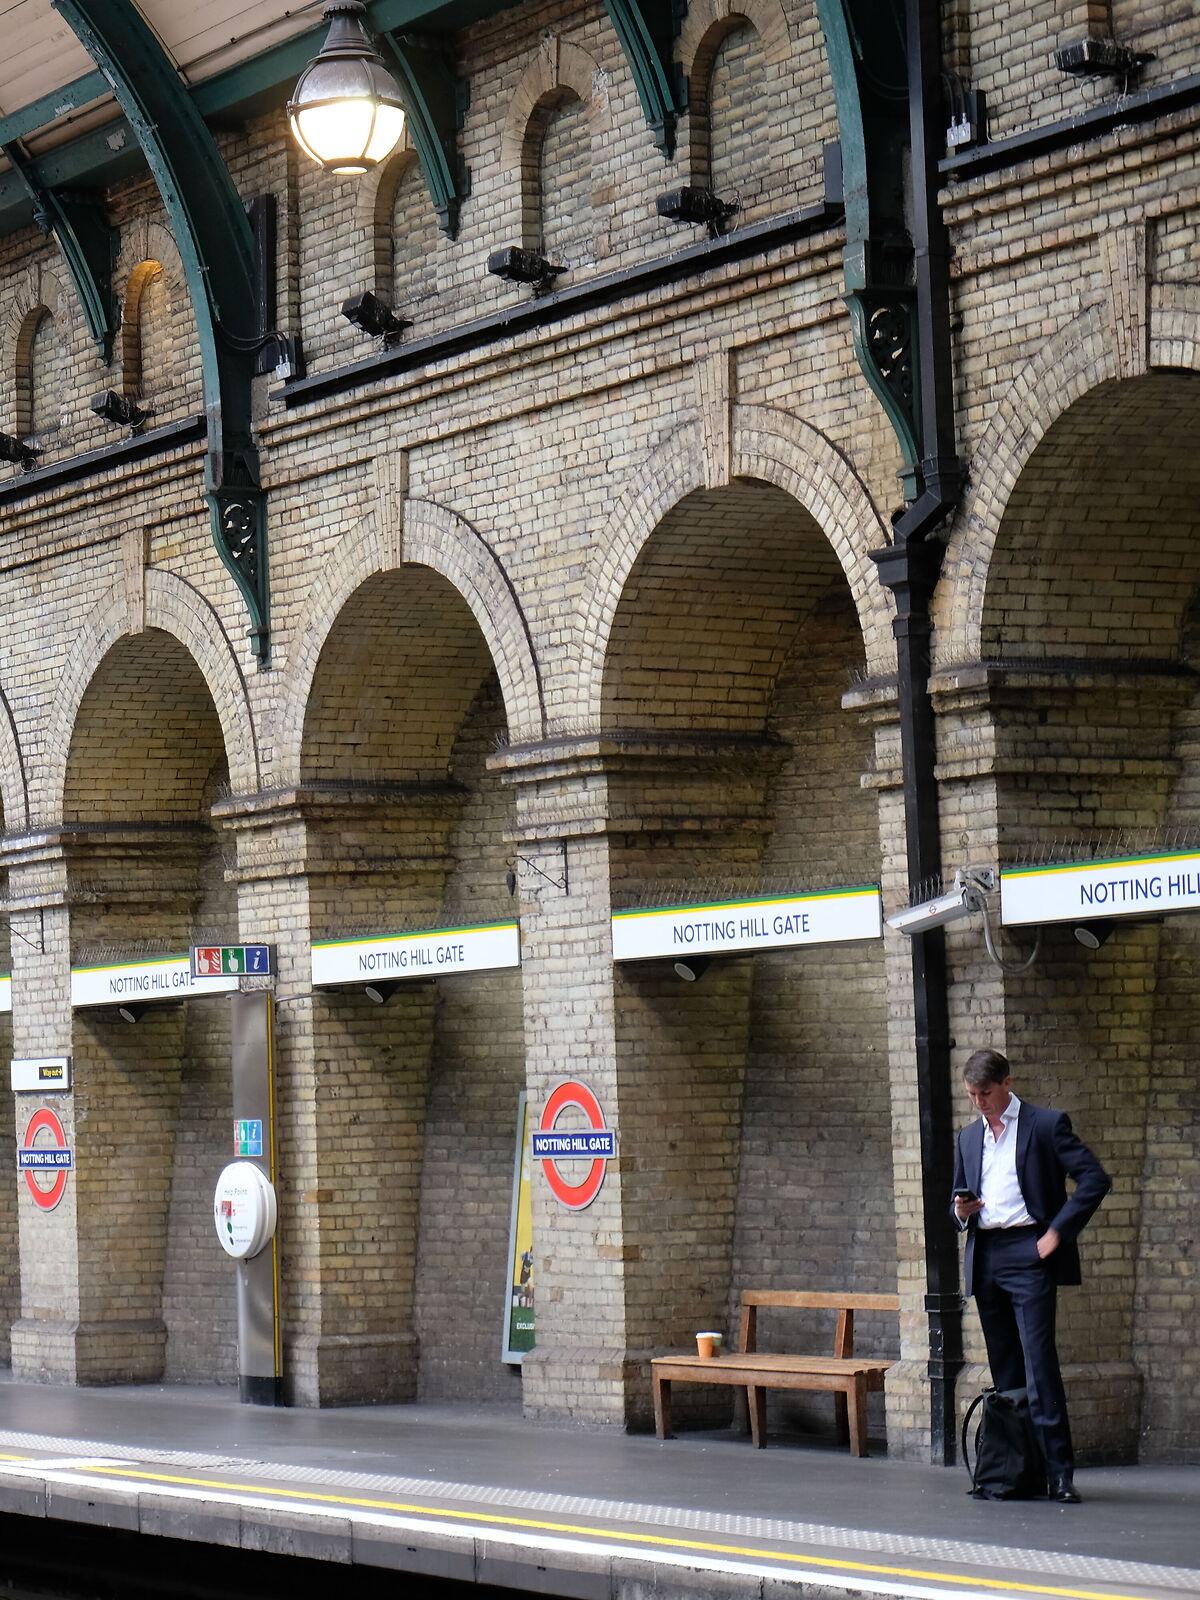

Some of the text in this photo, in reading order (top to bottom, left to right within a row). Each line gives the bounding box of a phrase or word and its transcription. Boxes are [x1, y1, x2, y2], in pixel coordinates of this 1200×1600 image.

[1080, 876, 1161, 905] NOTTING
[673, 913, 810, 944] NOTTING HILL GATE
[359, 945, 465, 971] NOTTING HILL GATE
[109, 975, 149, 994] NOTTING
[151, 973, 170, 990] HILL
[535, 1137, 611, 1151] NOTTING HILL GATE
[20, 1153, 70, 1164] NOTTING HILL GATE
